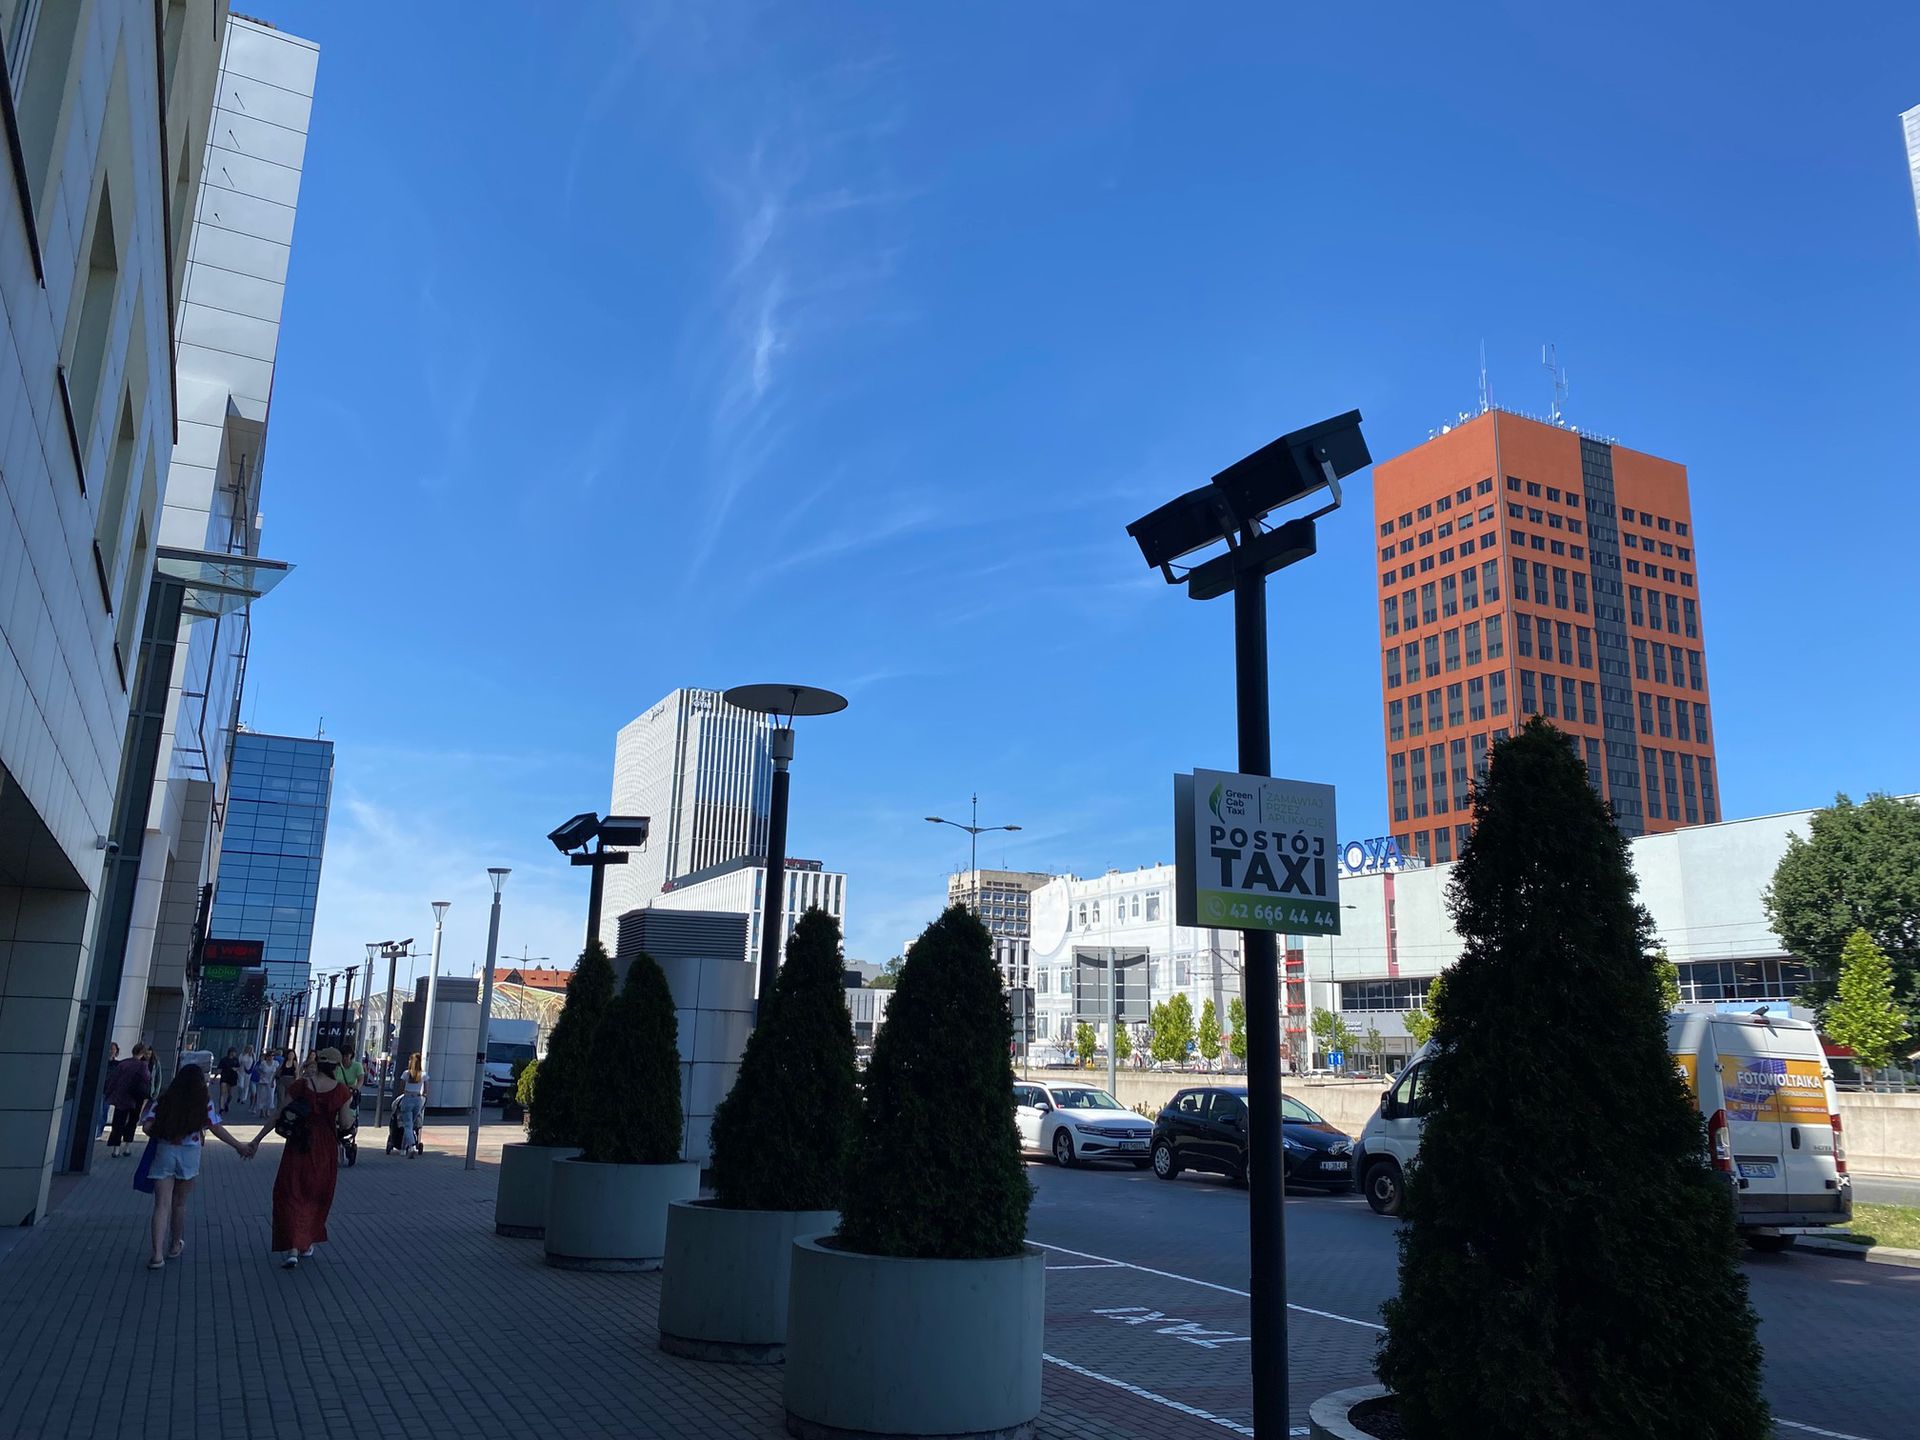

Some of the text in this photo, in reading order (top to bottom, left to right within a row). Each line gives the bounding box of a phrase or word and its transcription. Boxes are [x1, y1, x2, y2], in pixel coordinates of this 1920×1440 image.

[1225, 789, 1253, 800] Green
[1226, 797, 1245, 807] Cab
[1265, 792, 1324, 808] ZAMAWIAJ
[1226, 805, 1246, 816] Taxi
[1266, 802, 1302, 815] PRZEZ
[1210, 825, 1325, 857] POSTÓJ
[1210, 847, 1327, 897] TAXI
[1230, 902, 1334, 927] 42 666 44 44
[1736, 1070, 1824, 1089] FOTOWOLTAIKA
